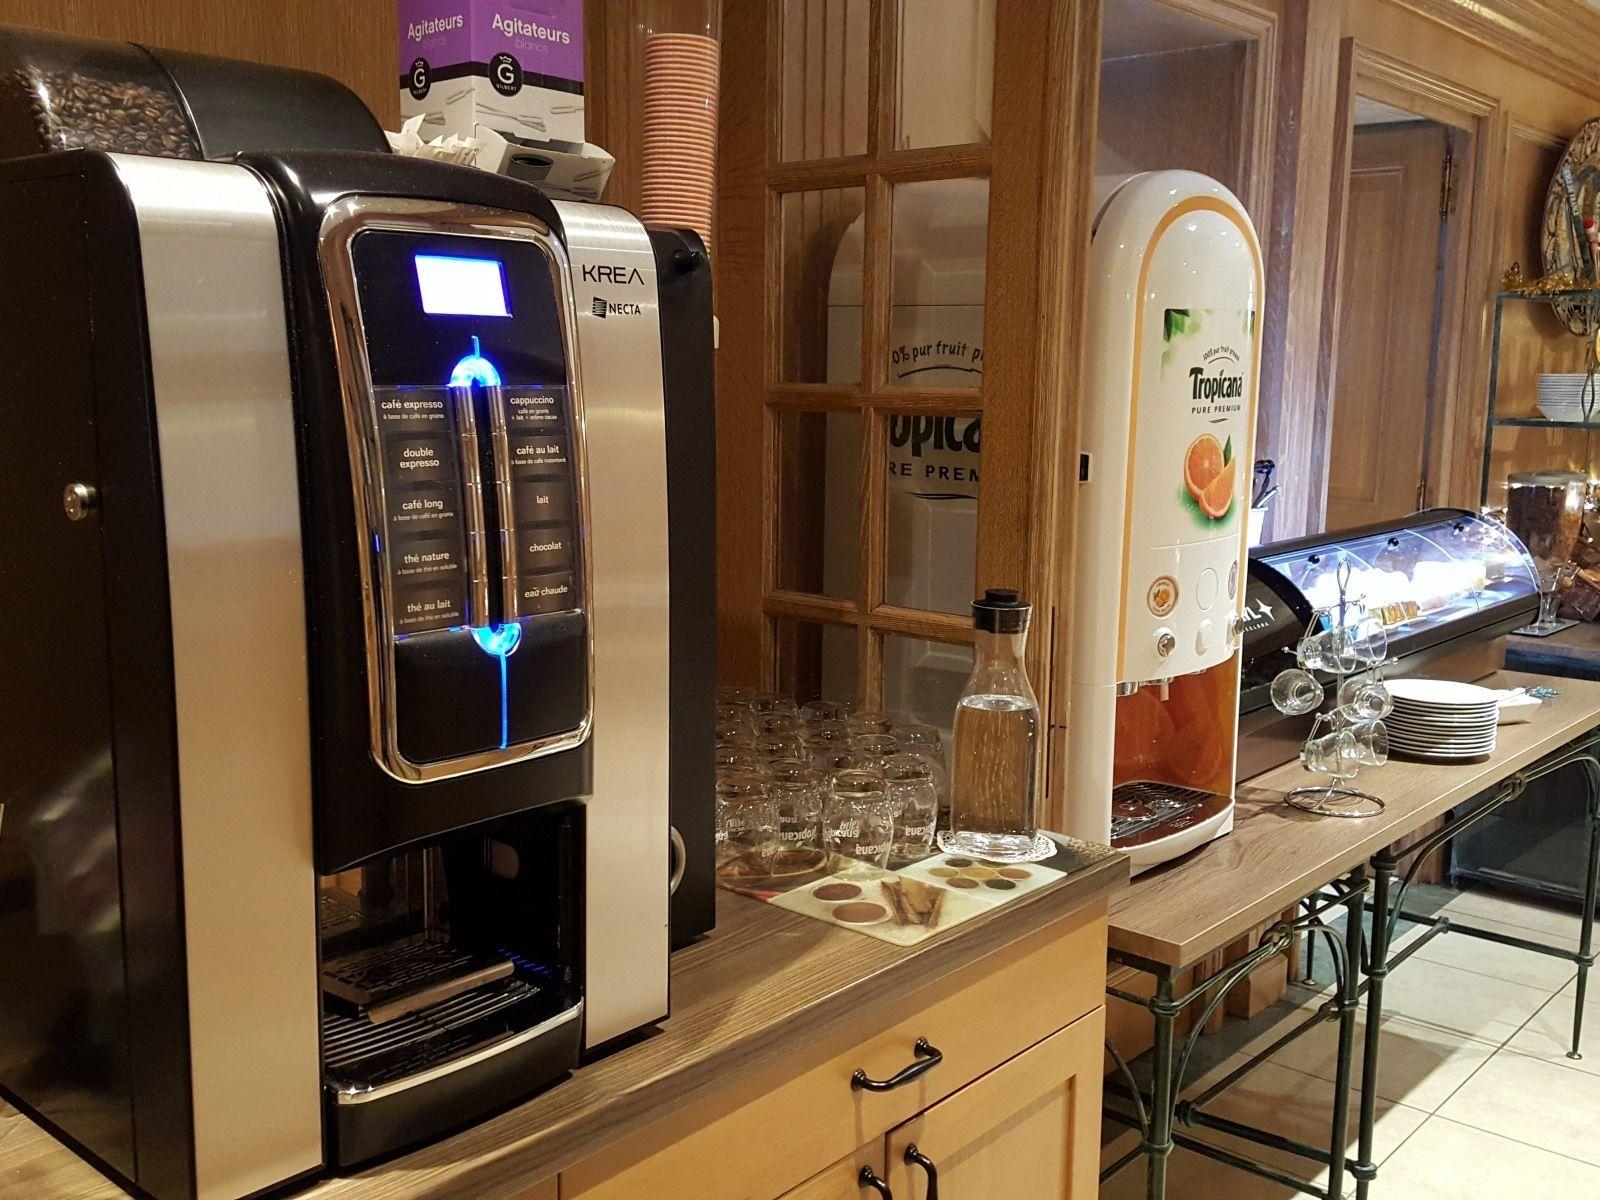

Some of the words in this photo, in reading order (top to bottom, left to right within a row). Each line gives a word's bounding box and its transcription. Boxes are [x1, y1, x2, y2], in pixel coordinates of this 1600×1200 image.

[408, 14, 464, 42] Agitateurs
[492, 13, 571, 45] Agitateurs
[497, 63, 515, 84] G
[582, 264, 645, 285] KREA
[608, 303, 642, 315] NECTA
[912, 343, 933, 362] pur
[936, 340, 968, 357] fruit
[1189, 366, 1243, 404] Tropicana
[381, 398, 402, 409] café
[403, 400, 444, 411] expresso
[510, 395, 555, 406] cappuccino
[1191, 406, 1211, 415] PURE
[890, 414, 982, 458] opica
[403, 447, 434, 458] double
[516, 446, 535, 455] café
[547, 445, 560, 454] lait
[399, 459, 440, 470] expresso
[889, 461, 913, 477] RE
[402, 498, 422, 510] café
[424, 499, 444, 510] long
[536, 495, 550, 504] lait
[529, 541, 563, 553] chocolat
[404, 553, 420, 564] thé
[421, 552, 450, 562] nature
[541, 585, 569, 597] chaude
[407, 602, 422, 613] thé
[424, 603, 435, 611] au
[436, 599, 452, 609] lait
